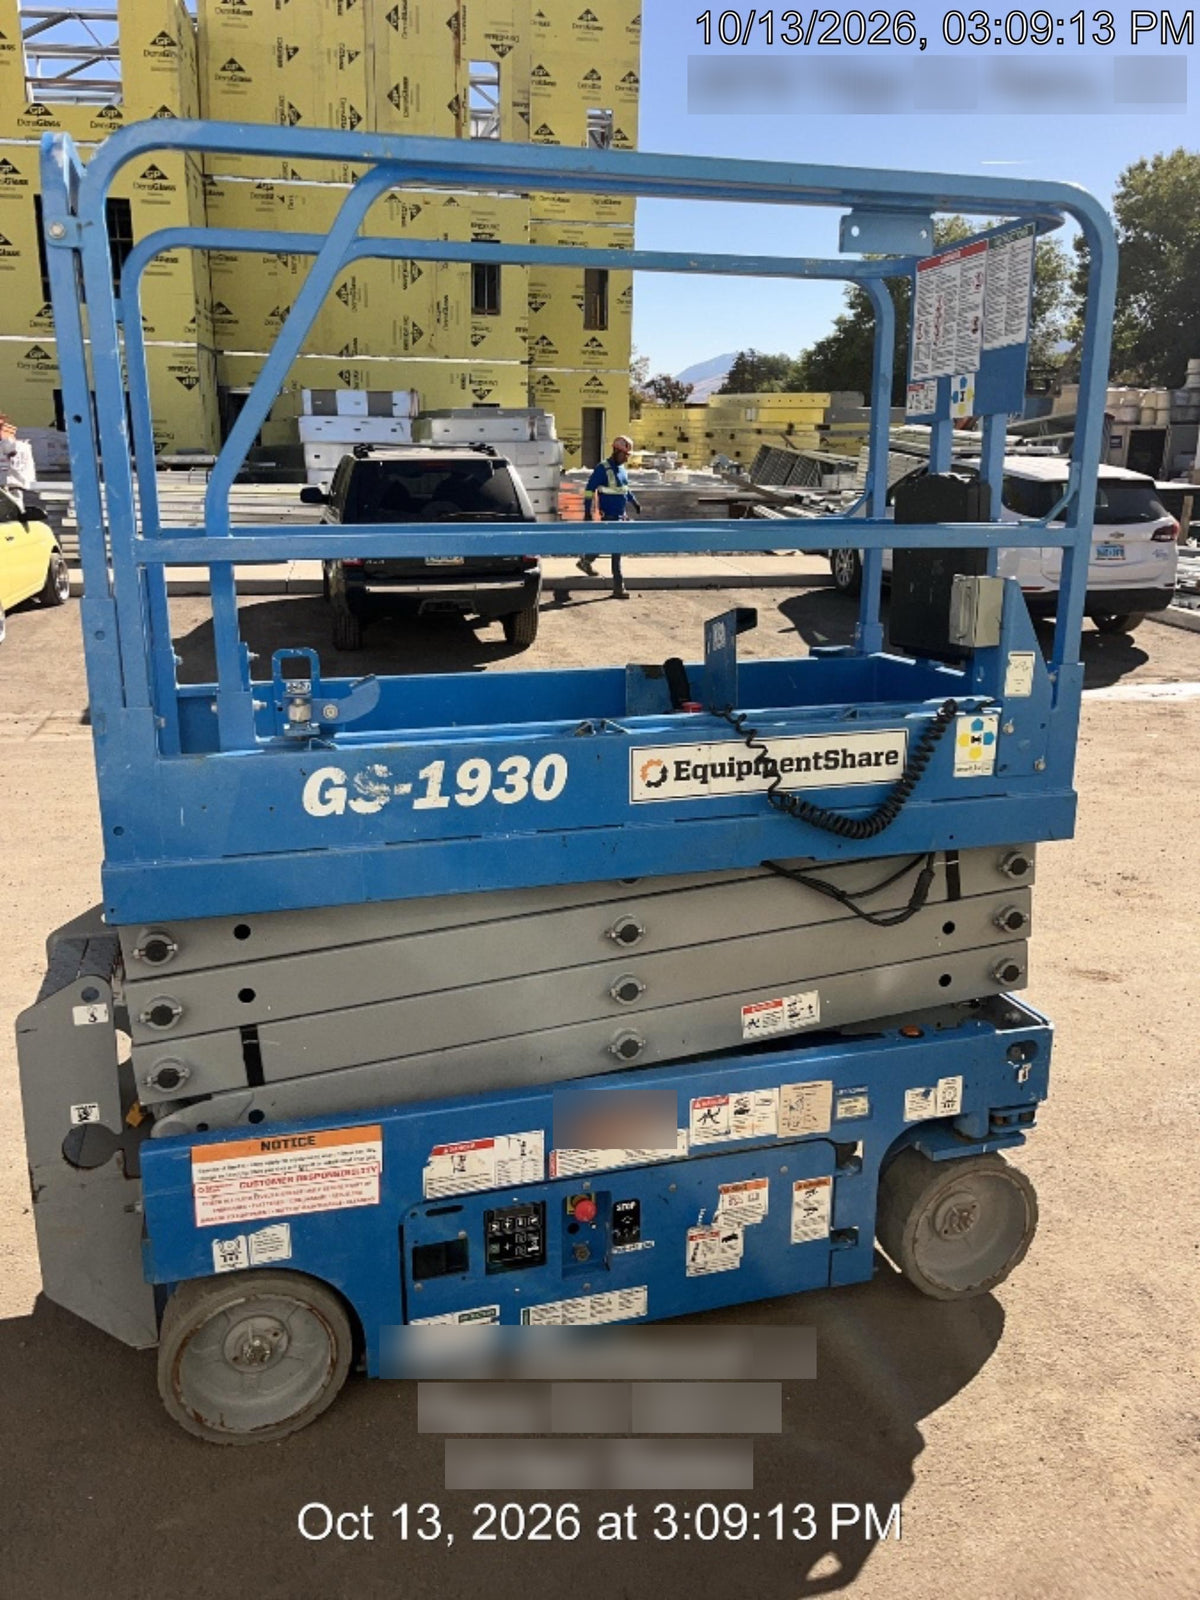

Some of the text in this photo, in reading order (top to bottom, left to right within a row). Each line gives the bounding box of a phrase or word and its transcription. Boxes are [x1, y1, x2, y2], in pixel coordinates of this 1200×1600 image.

[674, 749, 899, 784] EquipmentShare
[302, 753, 568, 817] GS-1930
[260, 1135, 317, 1151] NOTICE
